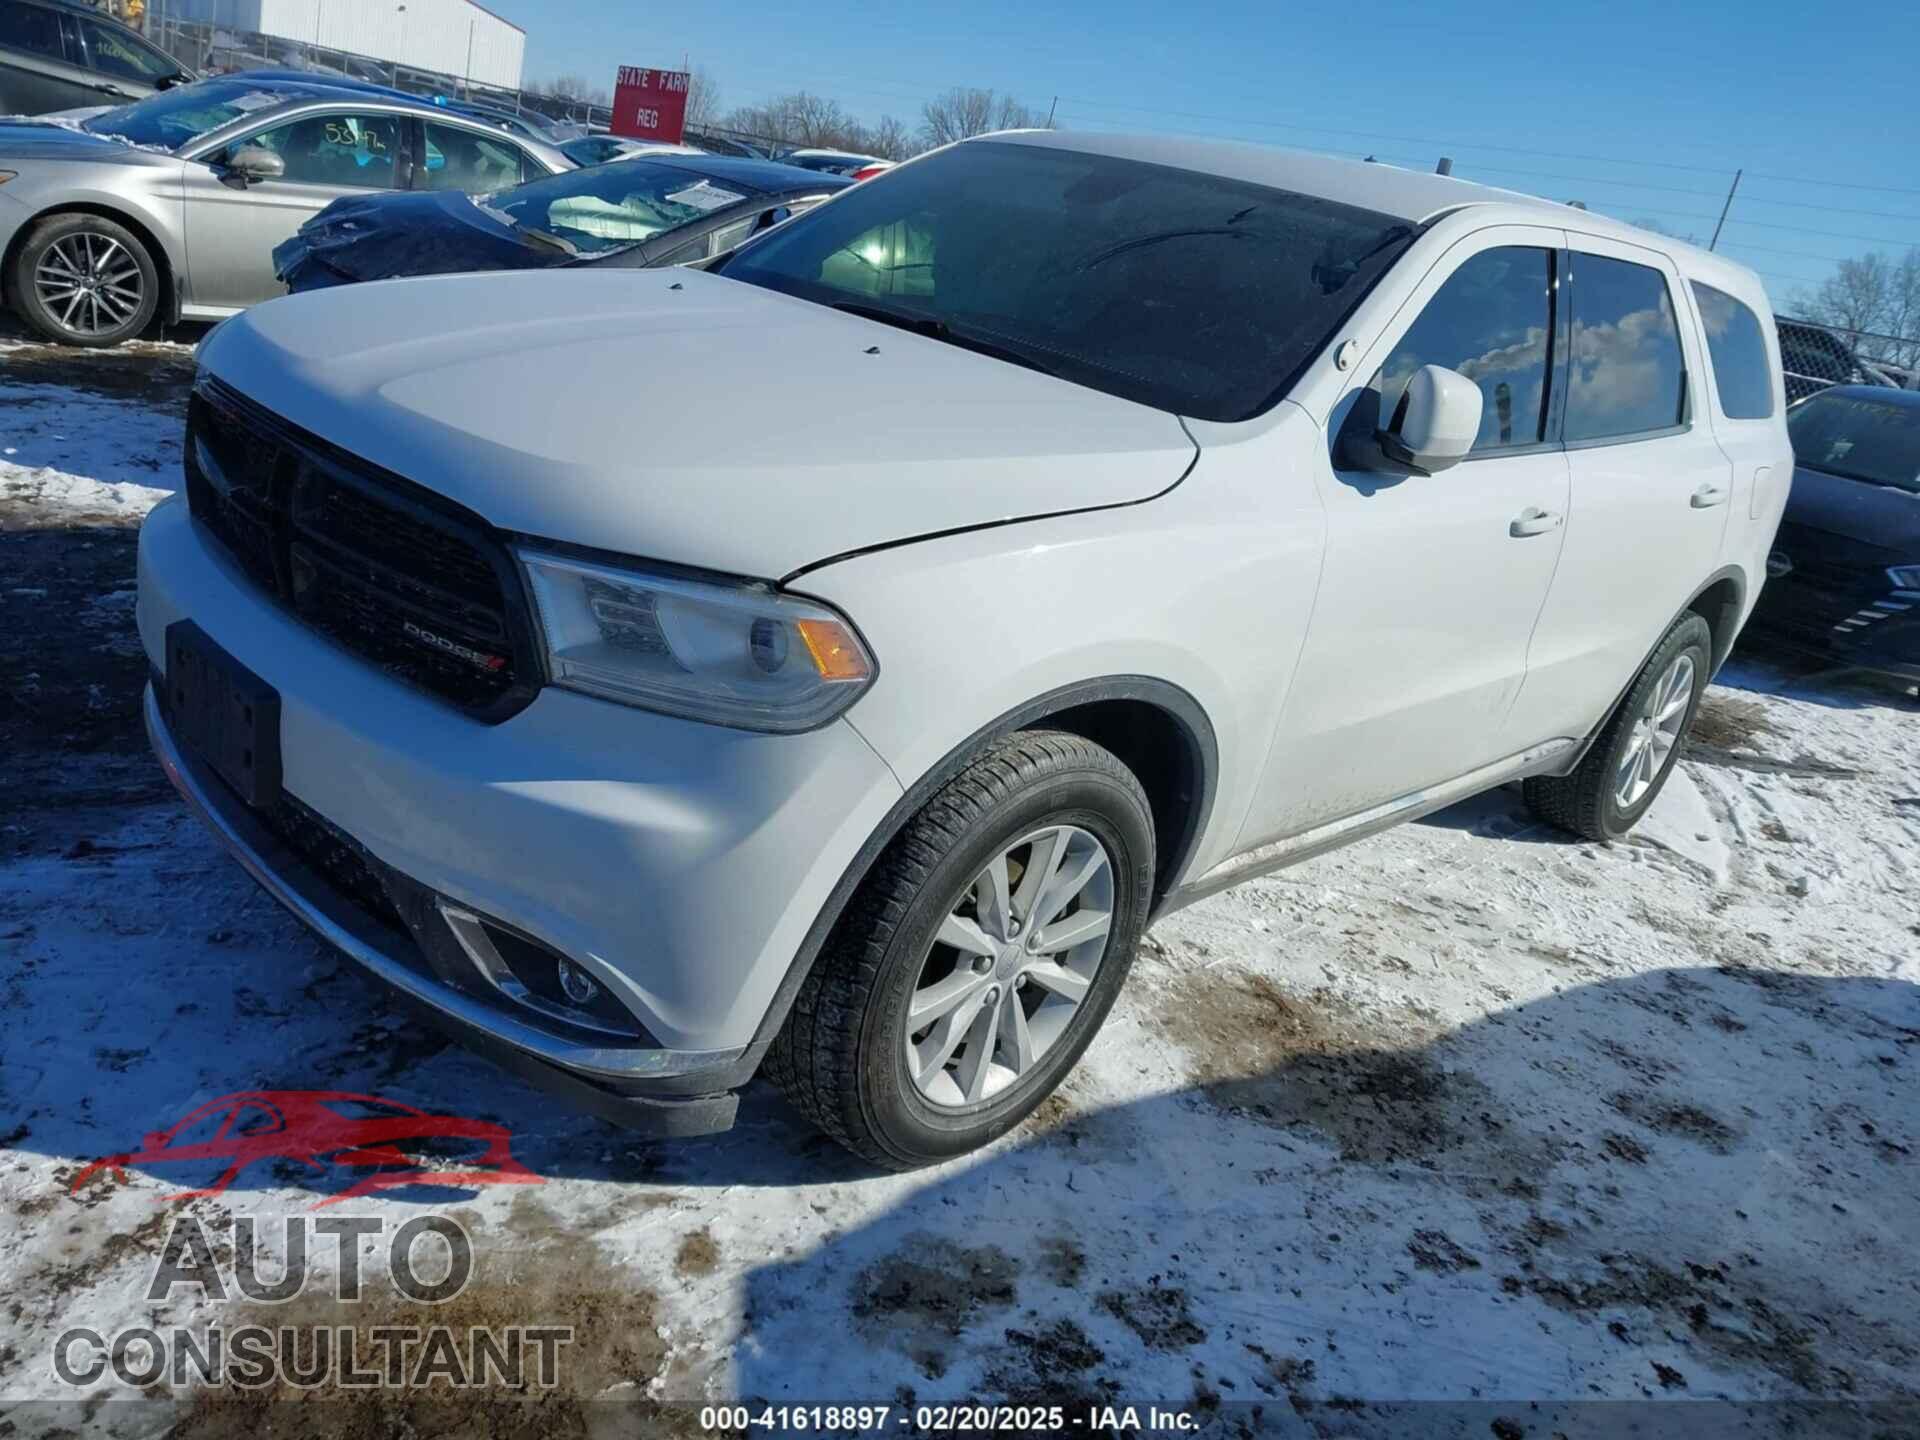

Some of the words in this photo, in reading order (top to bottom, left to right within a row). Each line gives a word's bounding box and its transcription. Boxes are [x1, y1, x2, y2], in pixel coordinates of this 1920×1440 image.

[616, 67, 650, 88] STATE
[658, 71, 688, 93] FARM
[636, 108, 658, 129] REG
[403, 622, 488, 671] DODGE
